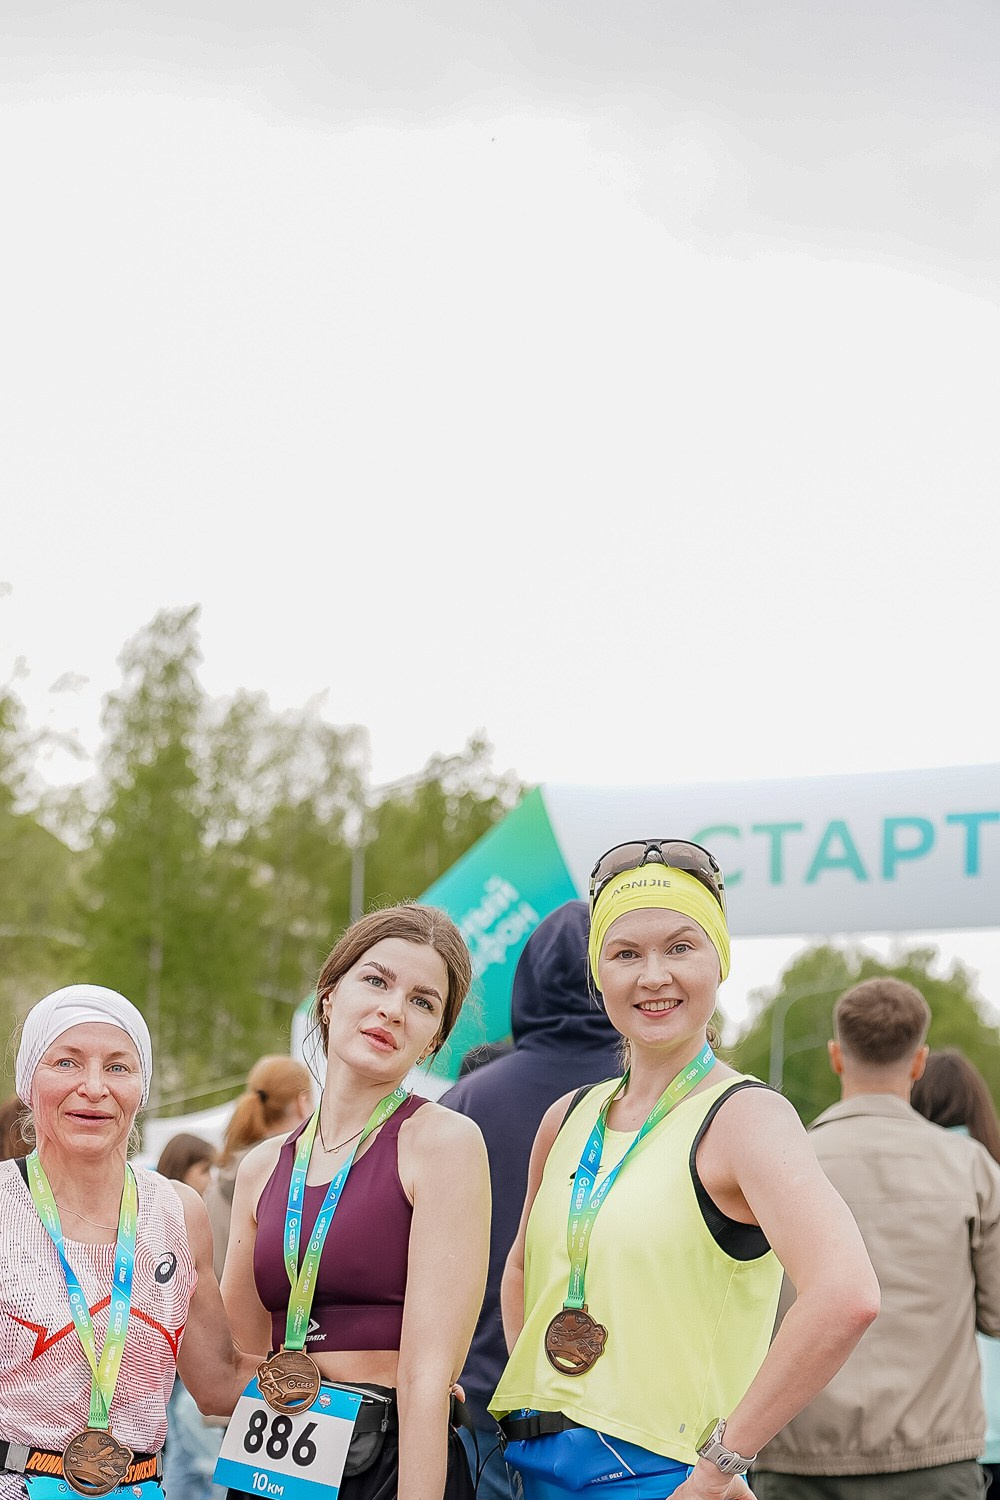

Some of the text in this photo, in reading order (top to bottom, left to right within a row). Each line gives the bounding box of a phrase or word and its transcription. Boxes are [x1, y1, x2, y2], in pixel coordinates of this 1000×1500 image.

[690, 811, 1000, 886] СТАРТ
[36, 1179, 45, 1194] 185
[575, 1188, 586, 1210] СБЕР
[302, 1279, 310, 1294] 185
[315, 1217, 326, 1240] СБЕР
[74, 1304, 89, 1328] СБЕР
[113, 1311, 123, 1336] СБЕР
[305, 1333, 327, 1342] EMIX
[107, 1345, 116, 1361] 185
[243, 1409, 319, 1467] 886
[26, 1452, 63, 1475] RUNN
